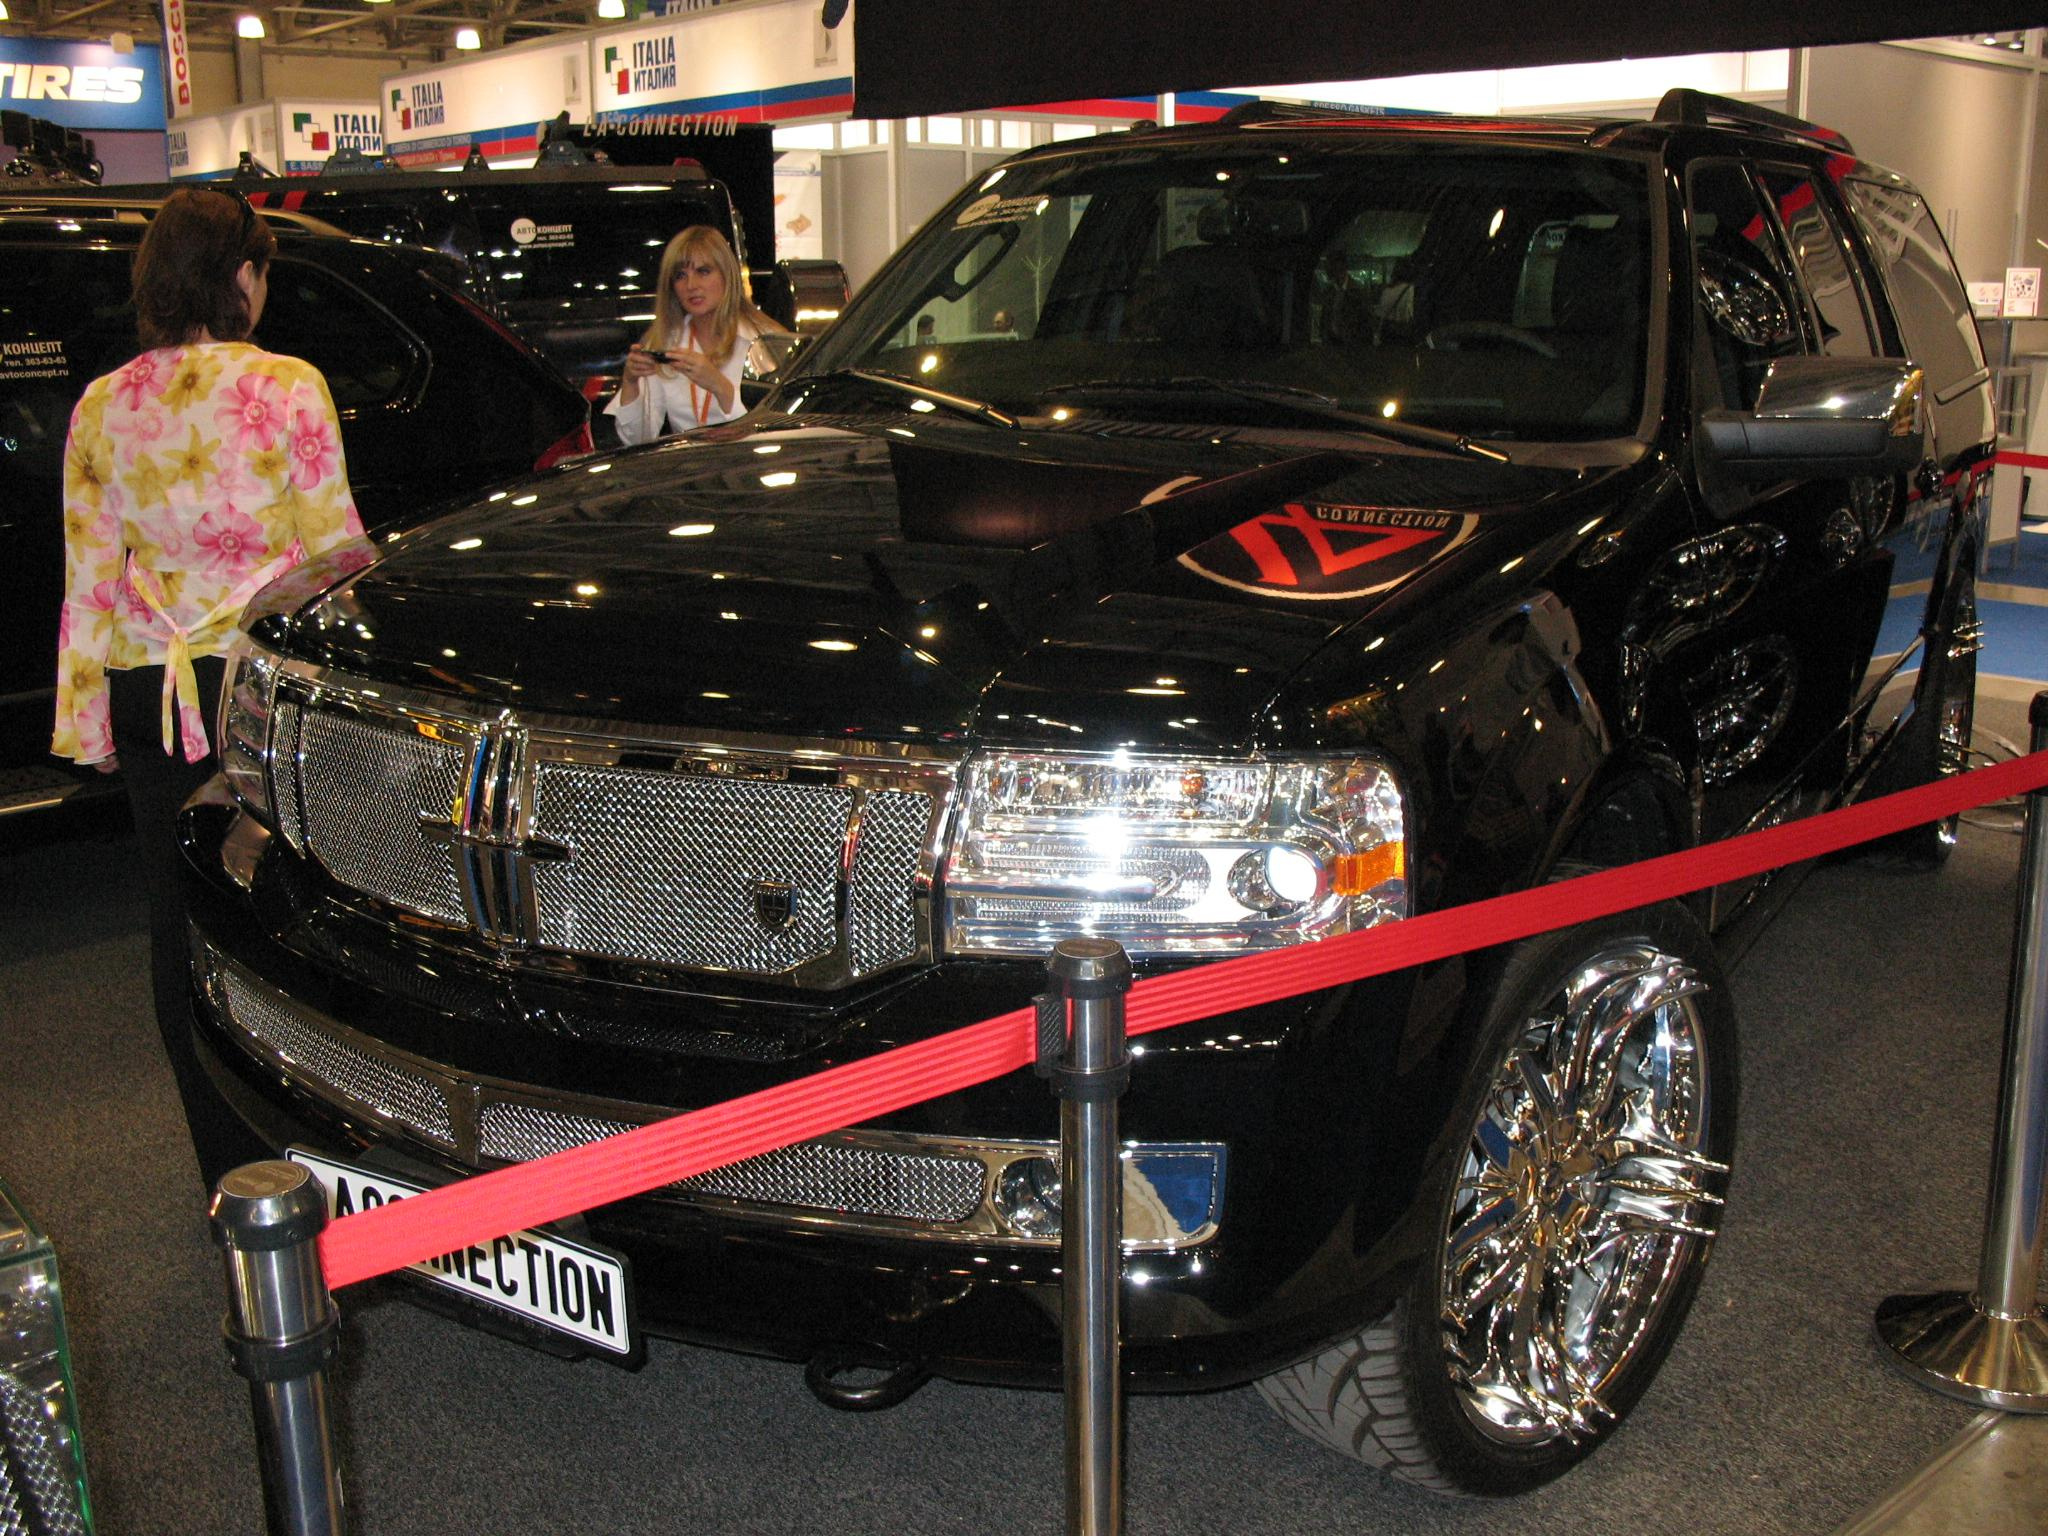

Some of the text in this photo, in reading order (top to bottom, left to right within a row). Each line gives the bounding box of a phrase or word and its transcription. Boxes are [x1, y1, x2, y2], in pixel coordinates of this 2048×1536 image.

[633, 36, 675, 69] ITALIA
[634, 65, 676, 92] ИТАЛИЯ
[412, 81, 443, 108] ITALIA
[334, 114, 382, 134] ITALI
[414, 105, 445, 128] ИТАЛИЯ
[3, 341, 63, 355] КОНЦЕПТ
